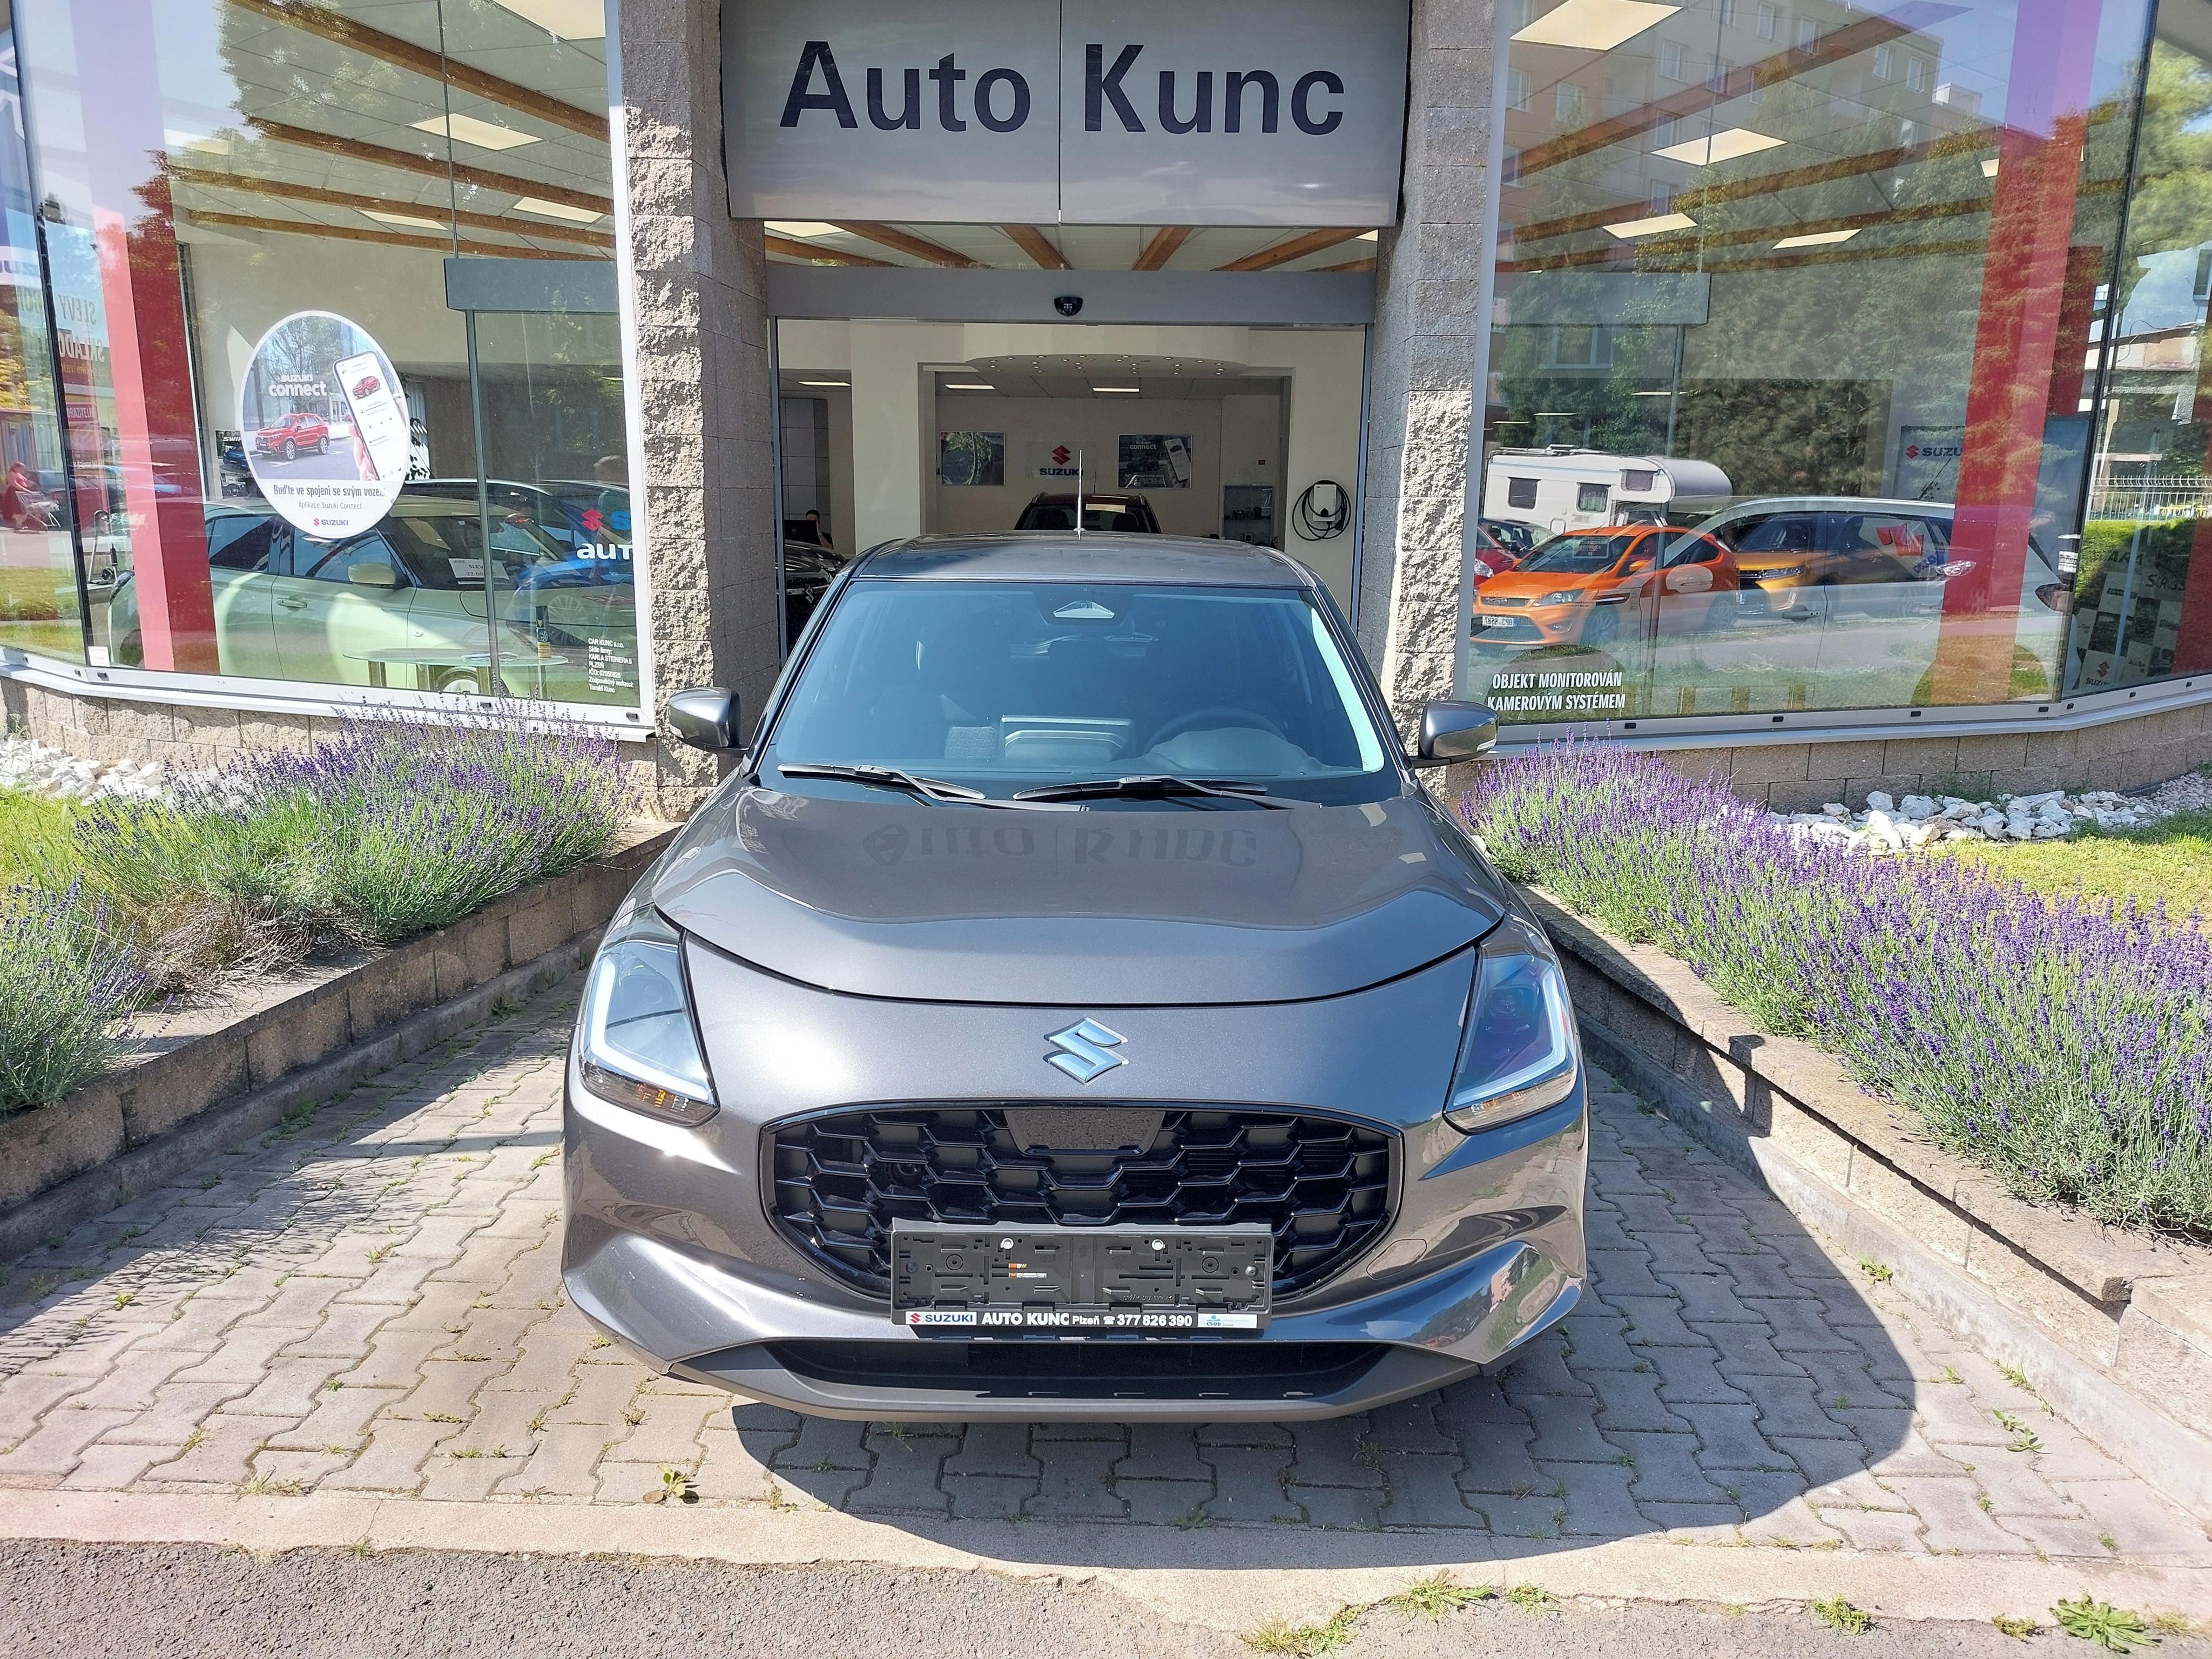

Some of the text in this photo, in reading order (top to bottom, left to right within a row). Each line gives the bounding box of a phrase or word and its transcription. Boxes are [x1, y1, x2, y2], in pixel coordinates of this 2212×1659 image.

[779, 41, 1345, 134] Auto Kunc
[269, 381, 328, 397] connect
[273, 484, 294, 495] Buďte
[296, 487, 304, 495] ve
[307, 485, 331, 497] spojení
[333, 488, 341, 496] se
[343, 485, 362, 497] svým
[599, 638, 613, 646] KUNC
[588, 660, 604, 669] PLZEŇ
[1492, 669, 1622, 689] OBJEKT MONITOROVÁN
[1487, 691, 1626, 711] KAMEROVÝM SYSTÉMEM
[925, 1312, 1192, 1326] SUZUKI AUTO KUNC Plzeň 377 826 390
